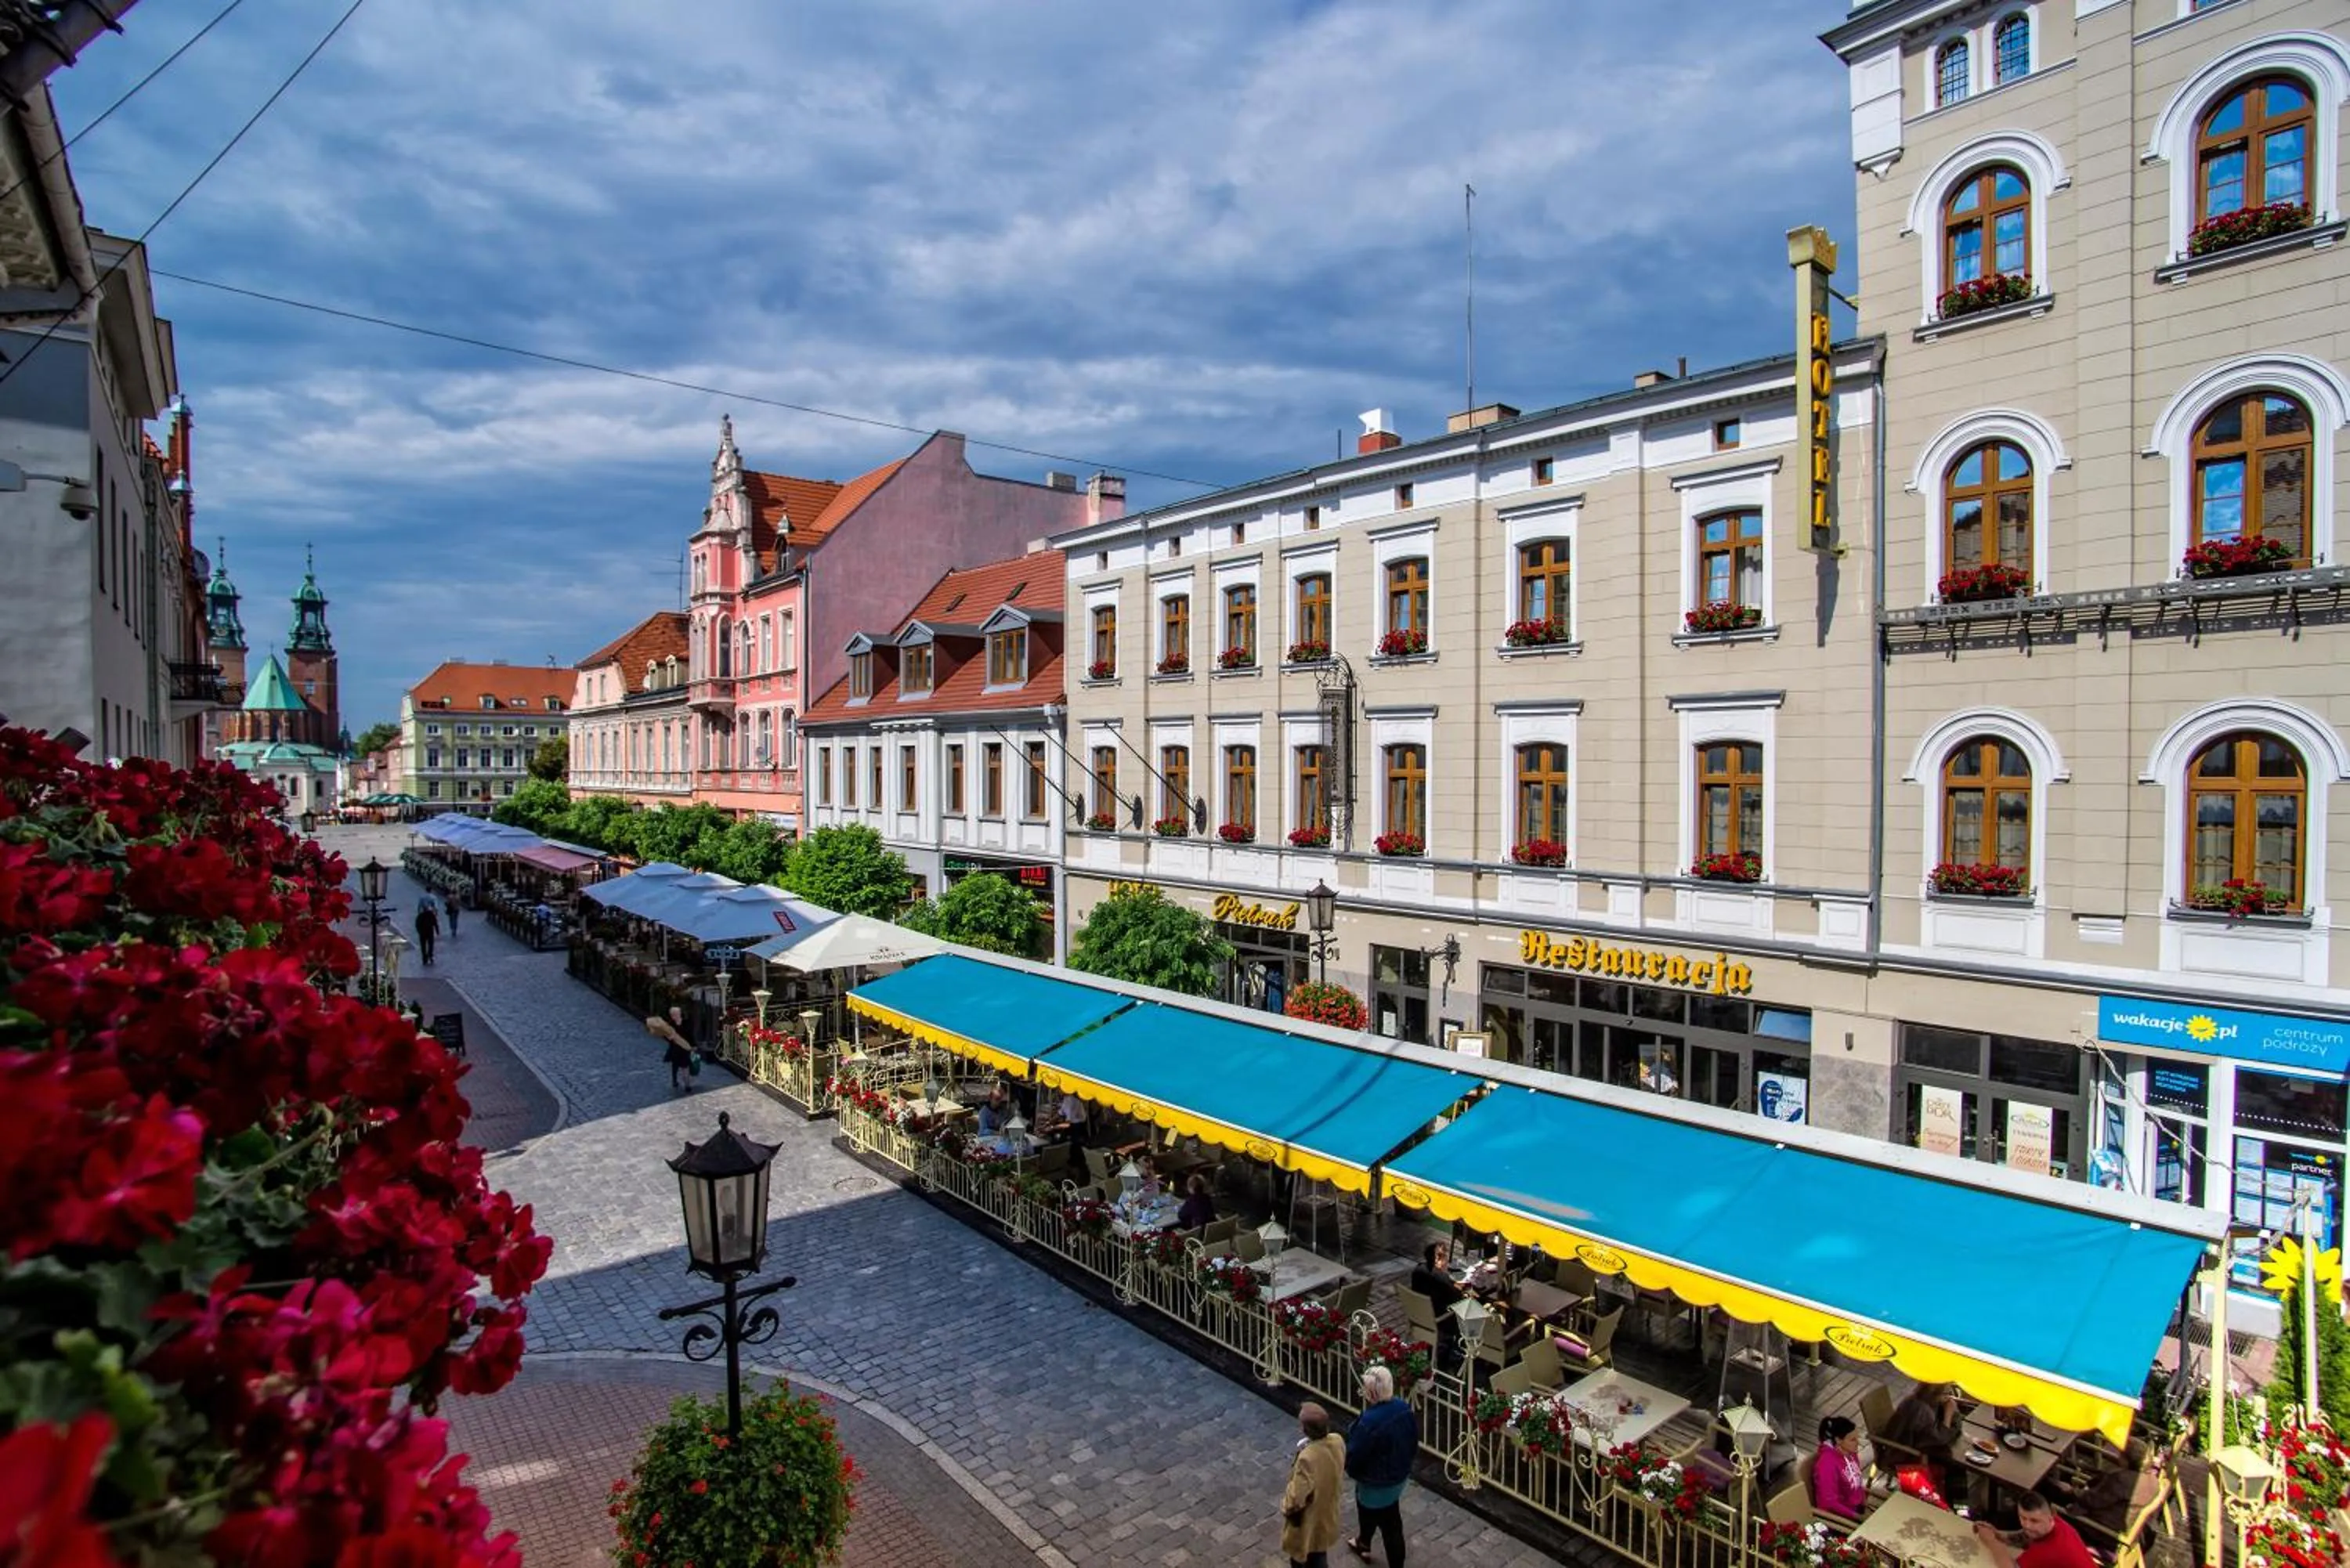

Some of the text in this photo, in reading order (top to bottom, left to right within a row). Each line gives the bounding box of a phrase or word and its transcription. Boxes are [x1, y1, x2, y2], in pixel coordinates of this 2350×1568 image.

[1520, 929, 1753, 996] Restauracja
[2113, 1013, 2184, 1032] wakacje
[2274, 1028, 2343, 1044] centrum
[2291, 1162, 2333, 1176] partner
